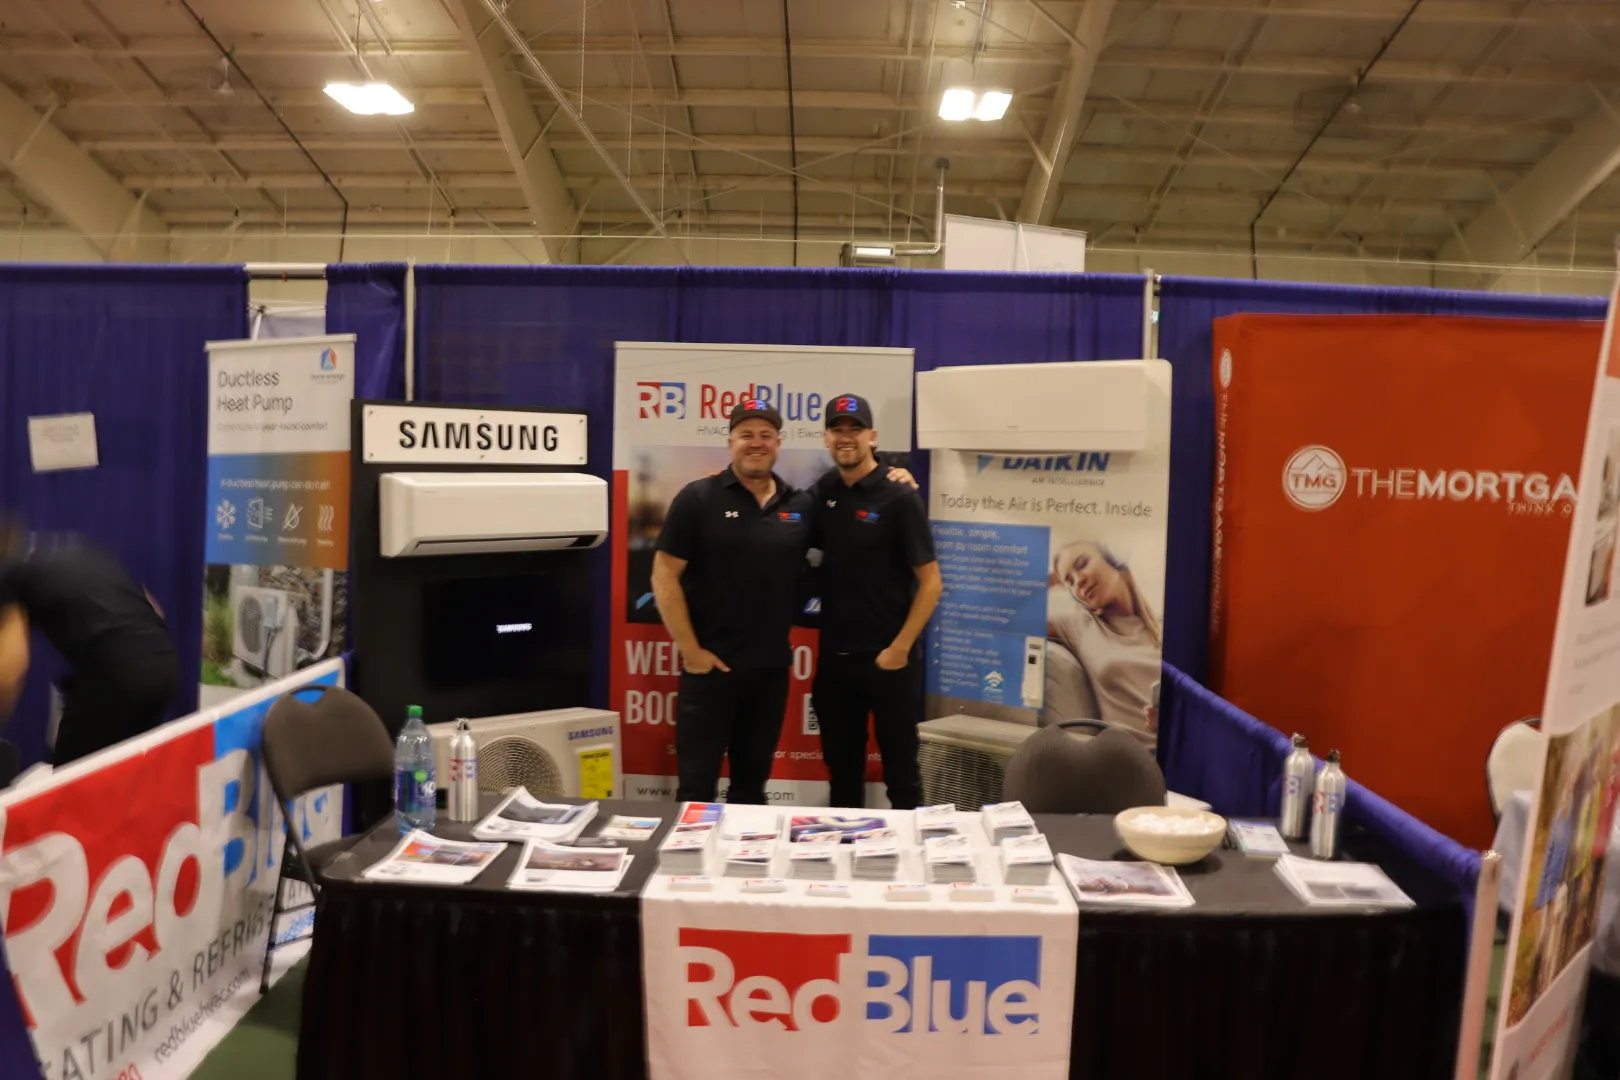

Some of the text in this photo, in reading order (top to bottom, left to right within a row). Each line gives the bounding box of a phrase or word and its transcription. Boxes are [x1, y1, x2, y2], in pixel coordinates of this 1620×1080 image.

[218, 370, 280, 388] Ductless
[218, 394, 293, 414] Heat Pump
[637, 381, 687, 419] RB
[835, 397, 859, 413] RB
[399, 419, 559, 451] SAMSUNG
[1002, 451, 1111, 471] DAIKIN
[1290, 473, 1337, 489] TMG
[940, 493, 1153, 518] Today the Air is Perfect. Inside
[1507, 501, 1555, 515] THINK
[568, 725, 614, 740] SAMSUNG
[789, 750, 824, 760] specia
[167, 969, 185, 1010] &
